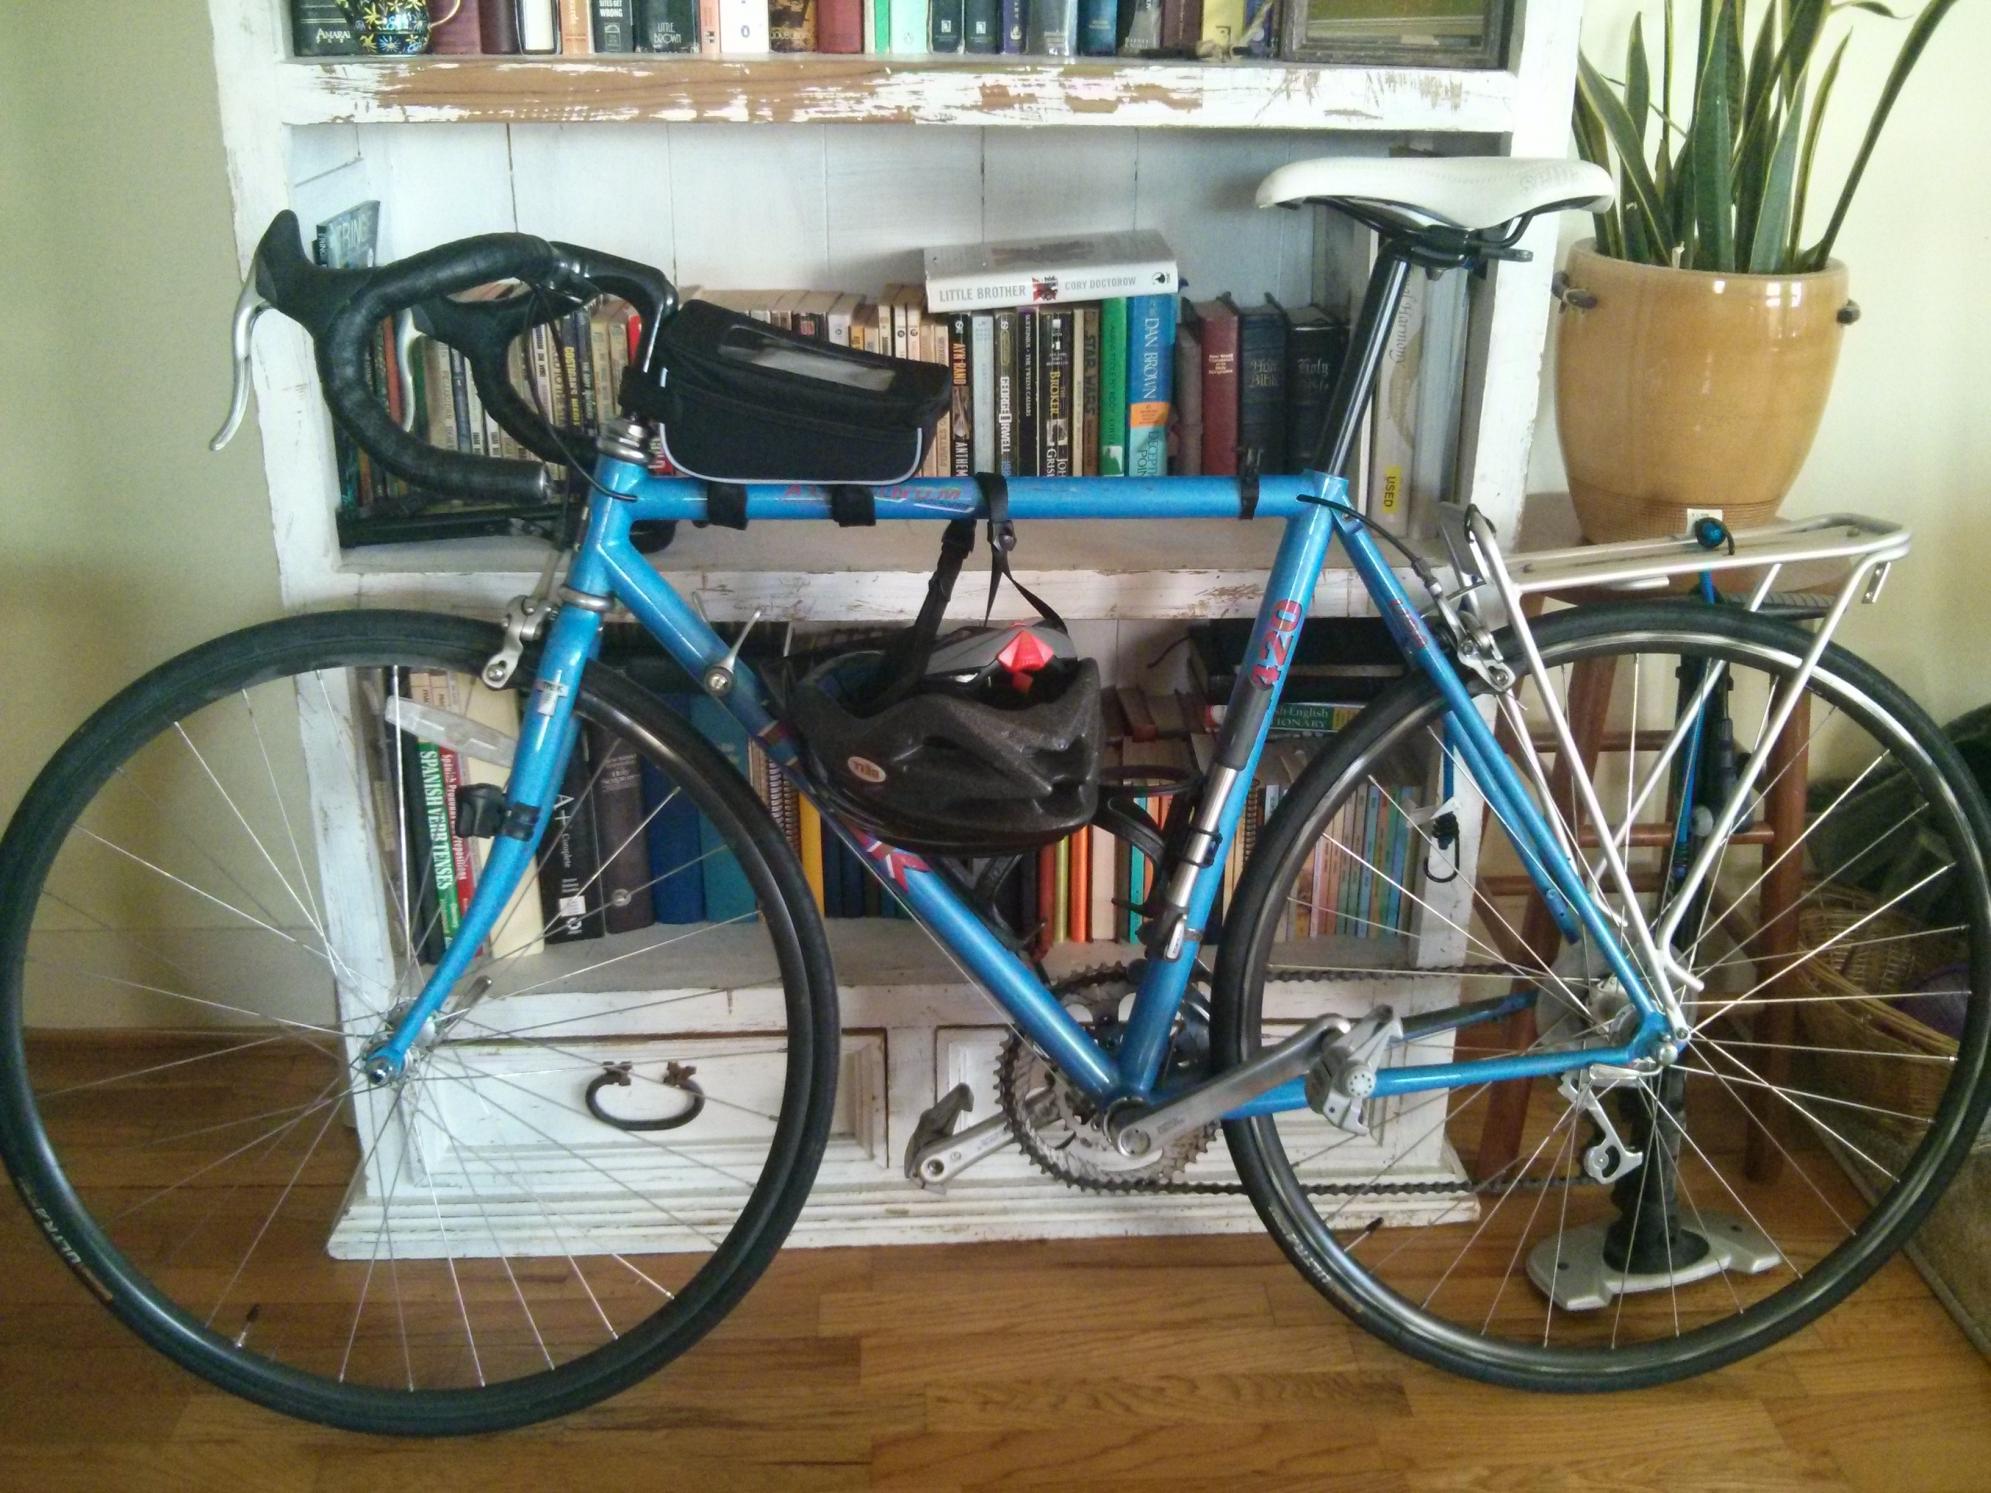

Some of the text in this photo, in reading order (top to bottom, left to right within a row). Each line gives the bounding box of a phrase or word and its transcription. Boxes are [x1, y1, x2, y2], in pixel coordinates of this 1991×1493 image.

[939, 277, 1136, 303] LITTLE BROTHER CORY DOCTOROW
[1143, 318, 1160, 347] DAN
[953, 343, 967, 385] AYN RAND
[1084, 334, 1096, 368] STAR
[1297, 358, 1329, 376] Holy
[1143, 351, 1159, 399] BROWN
[1050, 371, 1061, 416] BROKER
[1084, 375, 1096, 415] WARS
[999, 376, 1012, 454] GEORGE ORWELL
[955, 442, 969, 477] ANTHEM
[1046, 449, 1057, 477] GRIS
[1137, 450, 1149, 477] POIN
[1148, 431, 1161, 477] DECEPTI
[1384, 475, 1397, 508] USED
[420, 751, 443, 806] SPANISH
[442, 754, 456, 783] Spanish
[427, 808, 448, 842] VERB
[553, 794, 575, 826] A+
[432, 842, 454, 890] TENSES
[561, 833, 572, 868] Complete
